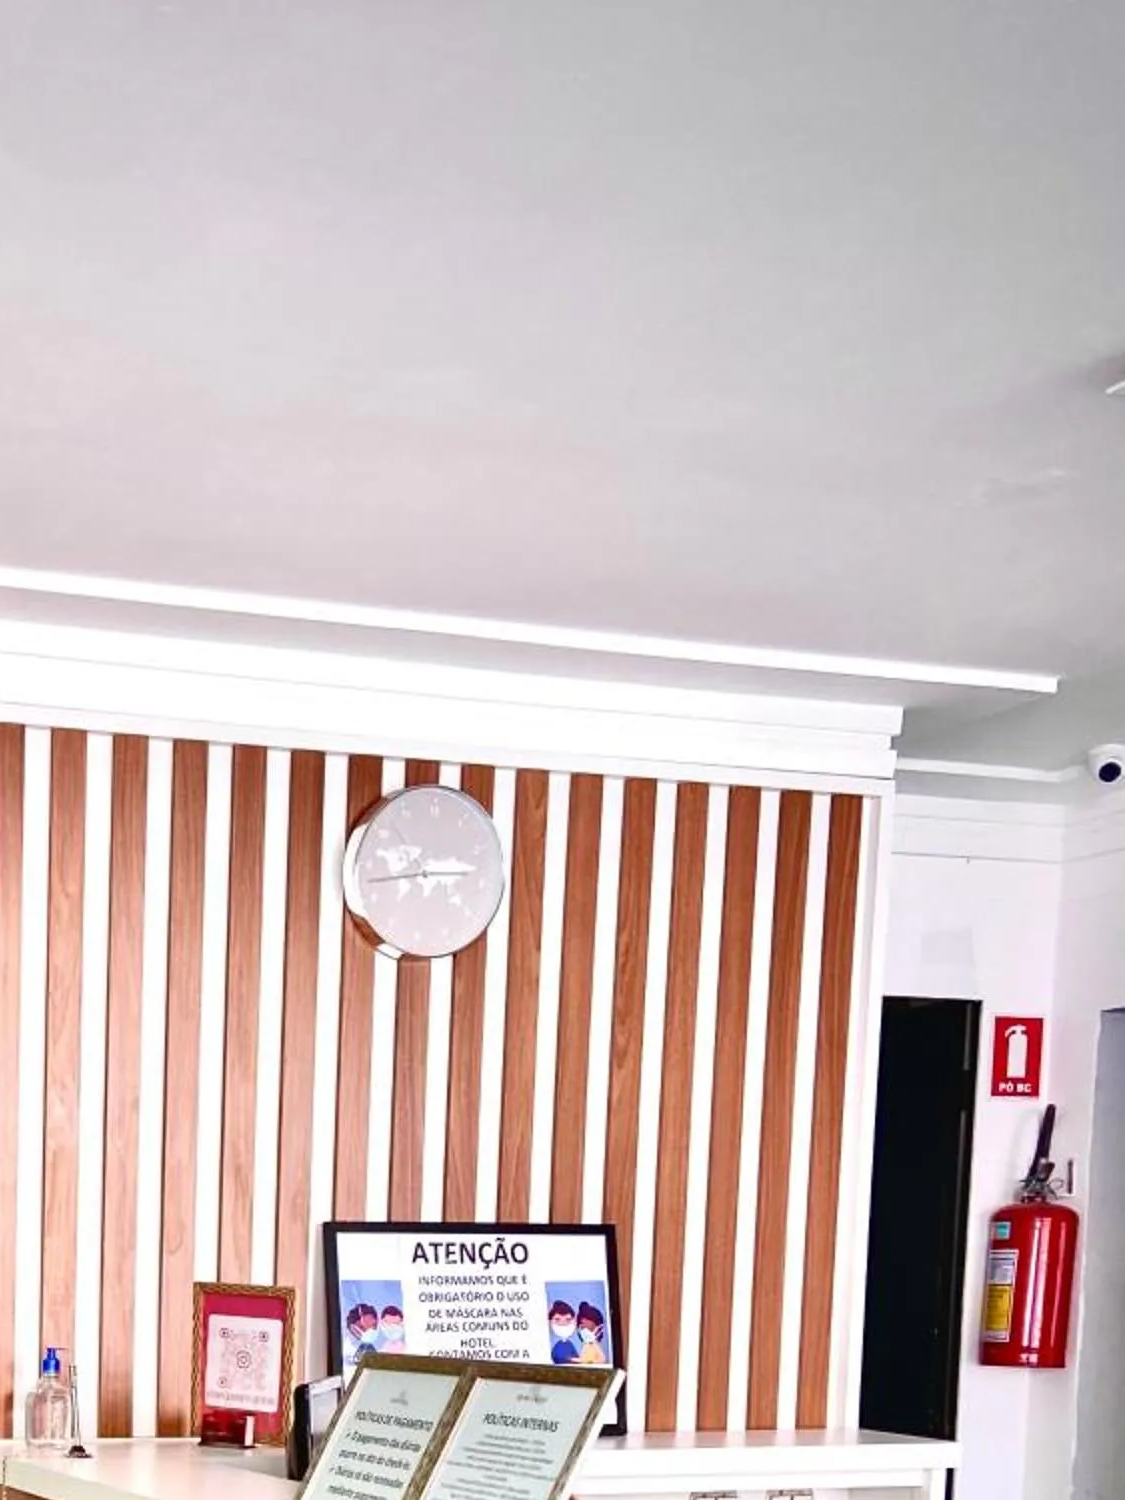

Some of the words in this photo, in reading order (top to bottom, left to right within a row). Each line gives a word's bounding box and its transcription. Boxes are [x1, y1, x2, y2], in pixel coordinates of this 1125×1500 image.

[998, 1080, 1014, 1093] PÓ
[412, 1237, 529, 1270] ATENÇÃO
[418, 1275, 493, 1286] INFORMAMOS
[496, 1275, 519, 1287] QUE
[418, 1290, 494, 1303] OBRIGATÓRIO
[496, 1292, 505, 1302] O
[507, 1291, 530, 1302] USO
[428, 1308, 442, 1319] DE
[446, 1306, 498, 1319] MÁSCARA
[500, 1308, 524, 1319] NAS
[425, 1319, 460, 1333] ÁREAS
[462, 1321, 510, 1333] COMUNS
[512, 1321, 529, 1332] DO
[494, 1349, 519, 1359] COM
[522, 1349, 530, 1359] A
[482, 1410, 522, 1429] POLÍTICAS
[522, 1416, 561, 1433] INTERNAS
